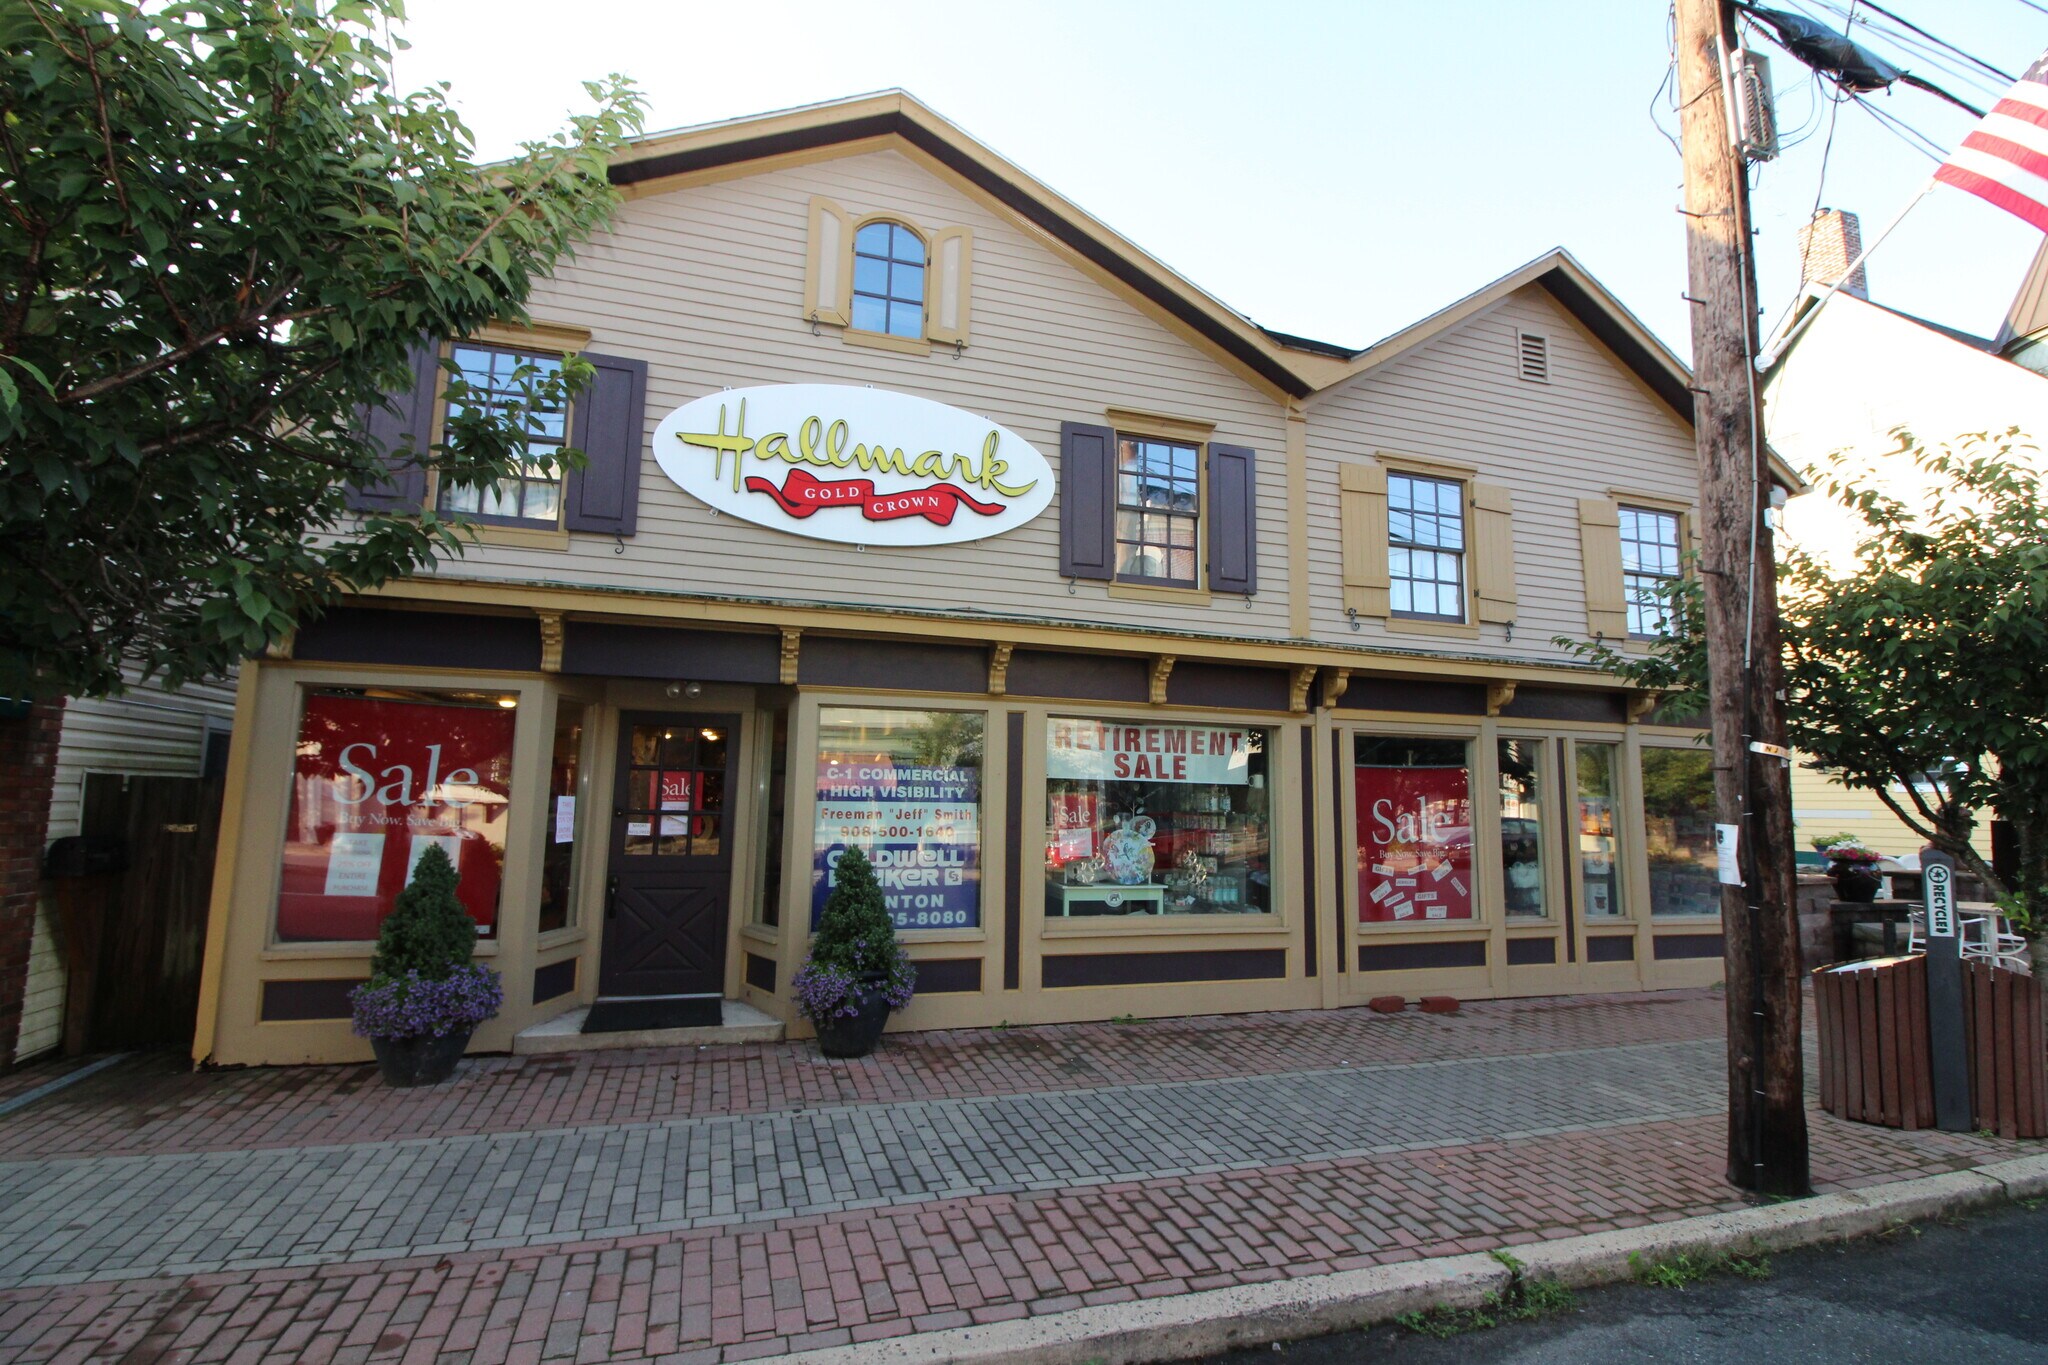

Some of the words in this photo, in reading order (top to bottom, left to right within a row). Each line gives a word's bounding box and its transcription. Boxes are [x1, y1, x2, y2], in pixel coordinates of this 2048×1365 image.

[675, 397, 1038, 497] Hallmark
[804, 486, 860, 500] GOLD
[873, 496, 940, 514] CROWN
[1055, 724, 1243, 756] RETIREMENT
[332, 742, 480, 808] Sale
[826, 767, 852, 780] C-1
[859, 767, 969, 782] COMMERCIAL
[1113, 753, 1187, 780] SALE
[830, 785, 874, 798] HIGH
[879, 786, 966, 799] VISIBILITY
[821, 808, 882, 820] Freeman
[935, 808, 973, 821] Smith
[1059, 805, 1091, 824] Sale
[1372, 796, 1451, 845] Sale
[827, 849, 965, 869] CLDWELL
[885, 894, 945, 909] NTON
[1932, 884, 1949, 927] RECYCLE
